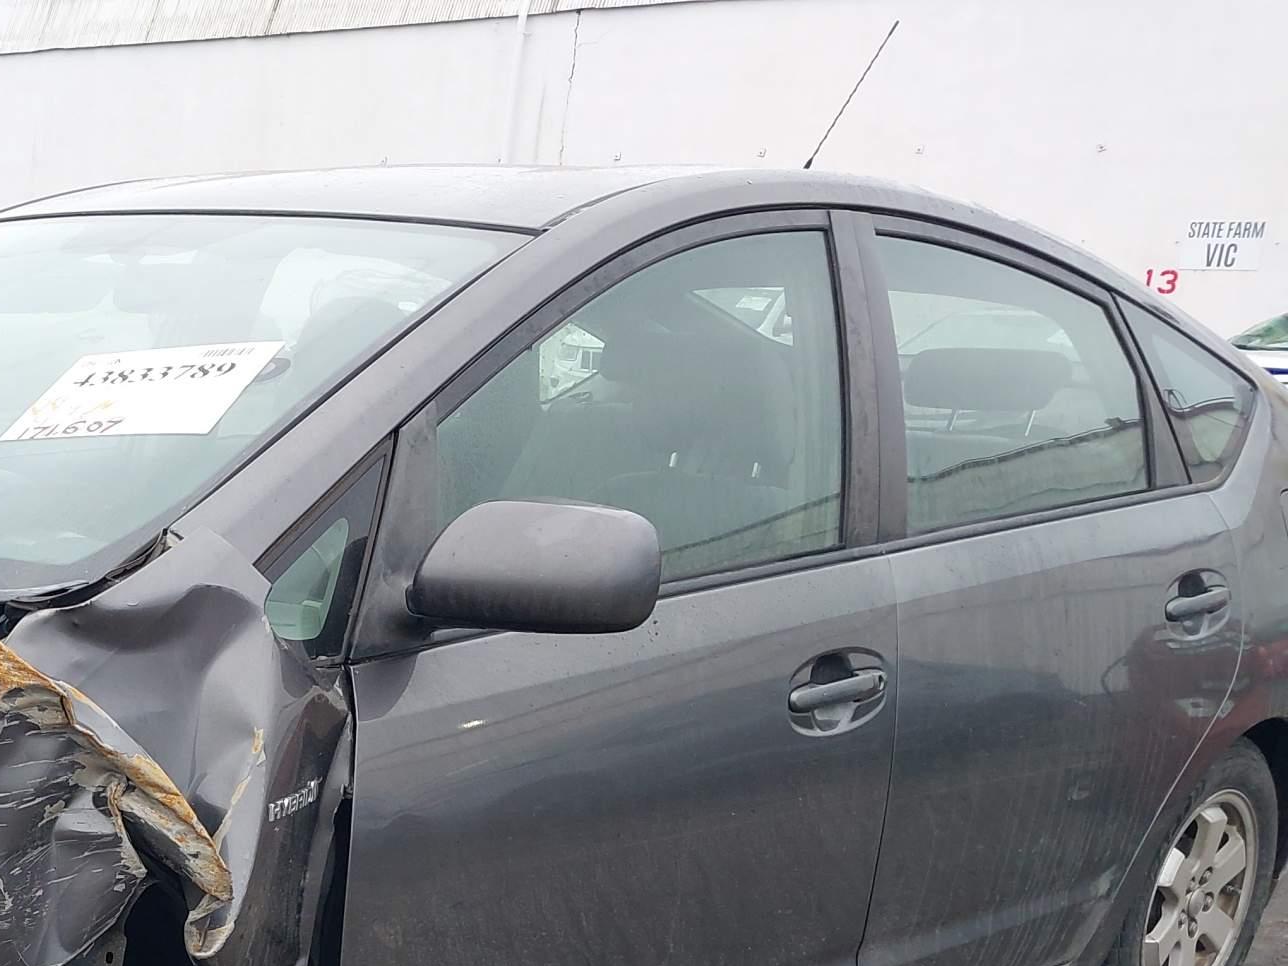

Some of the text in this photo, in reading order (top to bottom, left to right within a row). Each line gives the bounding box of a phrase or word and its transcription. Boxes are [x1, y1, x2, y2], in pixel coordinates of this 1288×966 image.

[1188, 221, 1266, 239] STATE FARM
[1205, 243, 1238, 268] VIC
[1145, 268, 1179, 295] 13
[73, 361, 237, 387] 43833789
